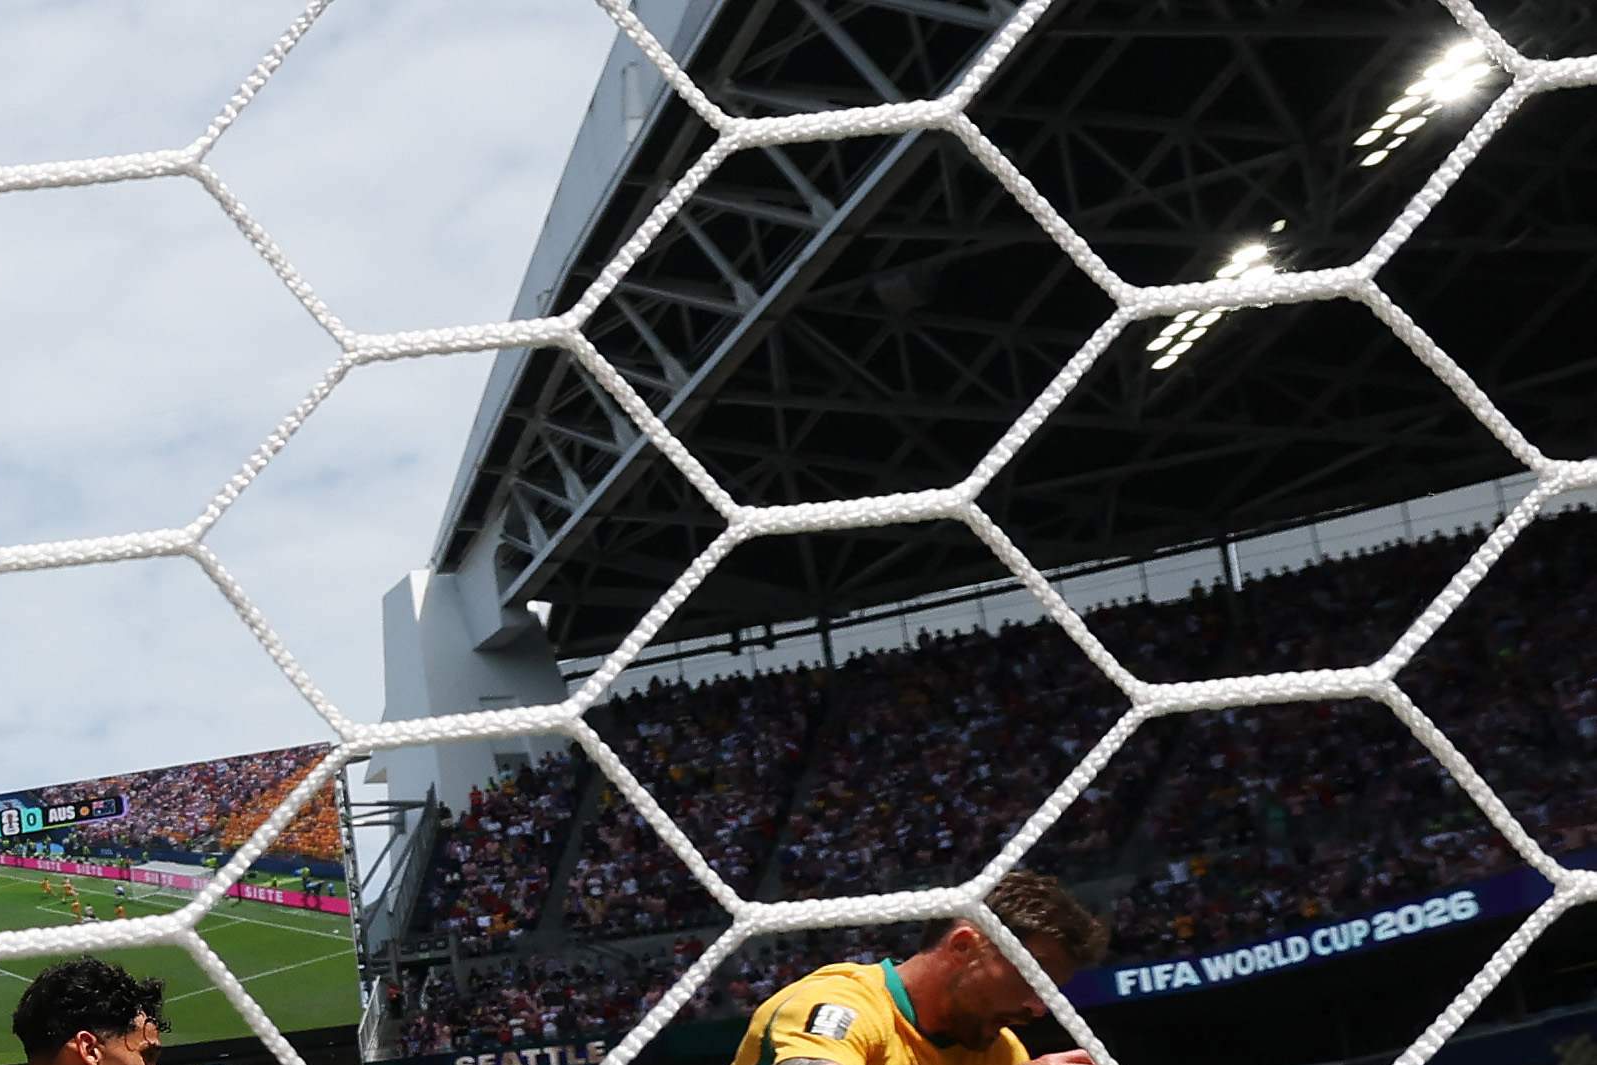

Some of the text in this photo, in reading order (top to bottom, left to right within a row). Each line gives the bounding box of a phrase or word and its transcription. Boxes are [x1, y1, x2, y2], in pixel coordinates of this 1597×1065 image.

[27, 812, 37, 827] 0
[48, 805, 76, 823] AUS
[244, 886, 284, 903] SIETE
[1115, 890, 1480, 996] FIFA WORLD CUP 2026
